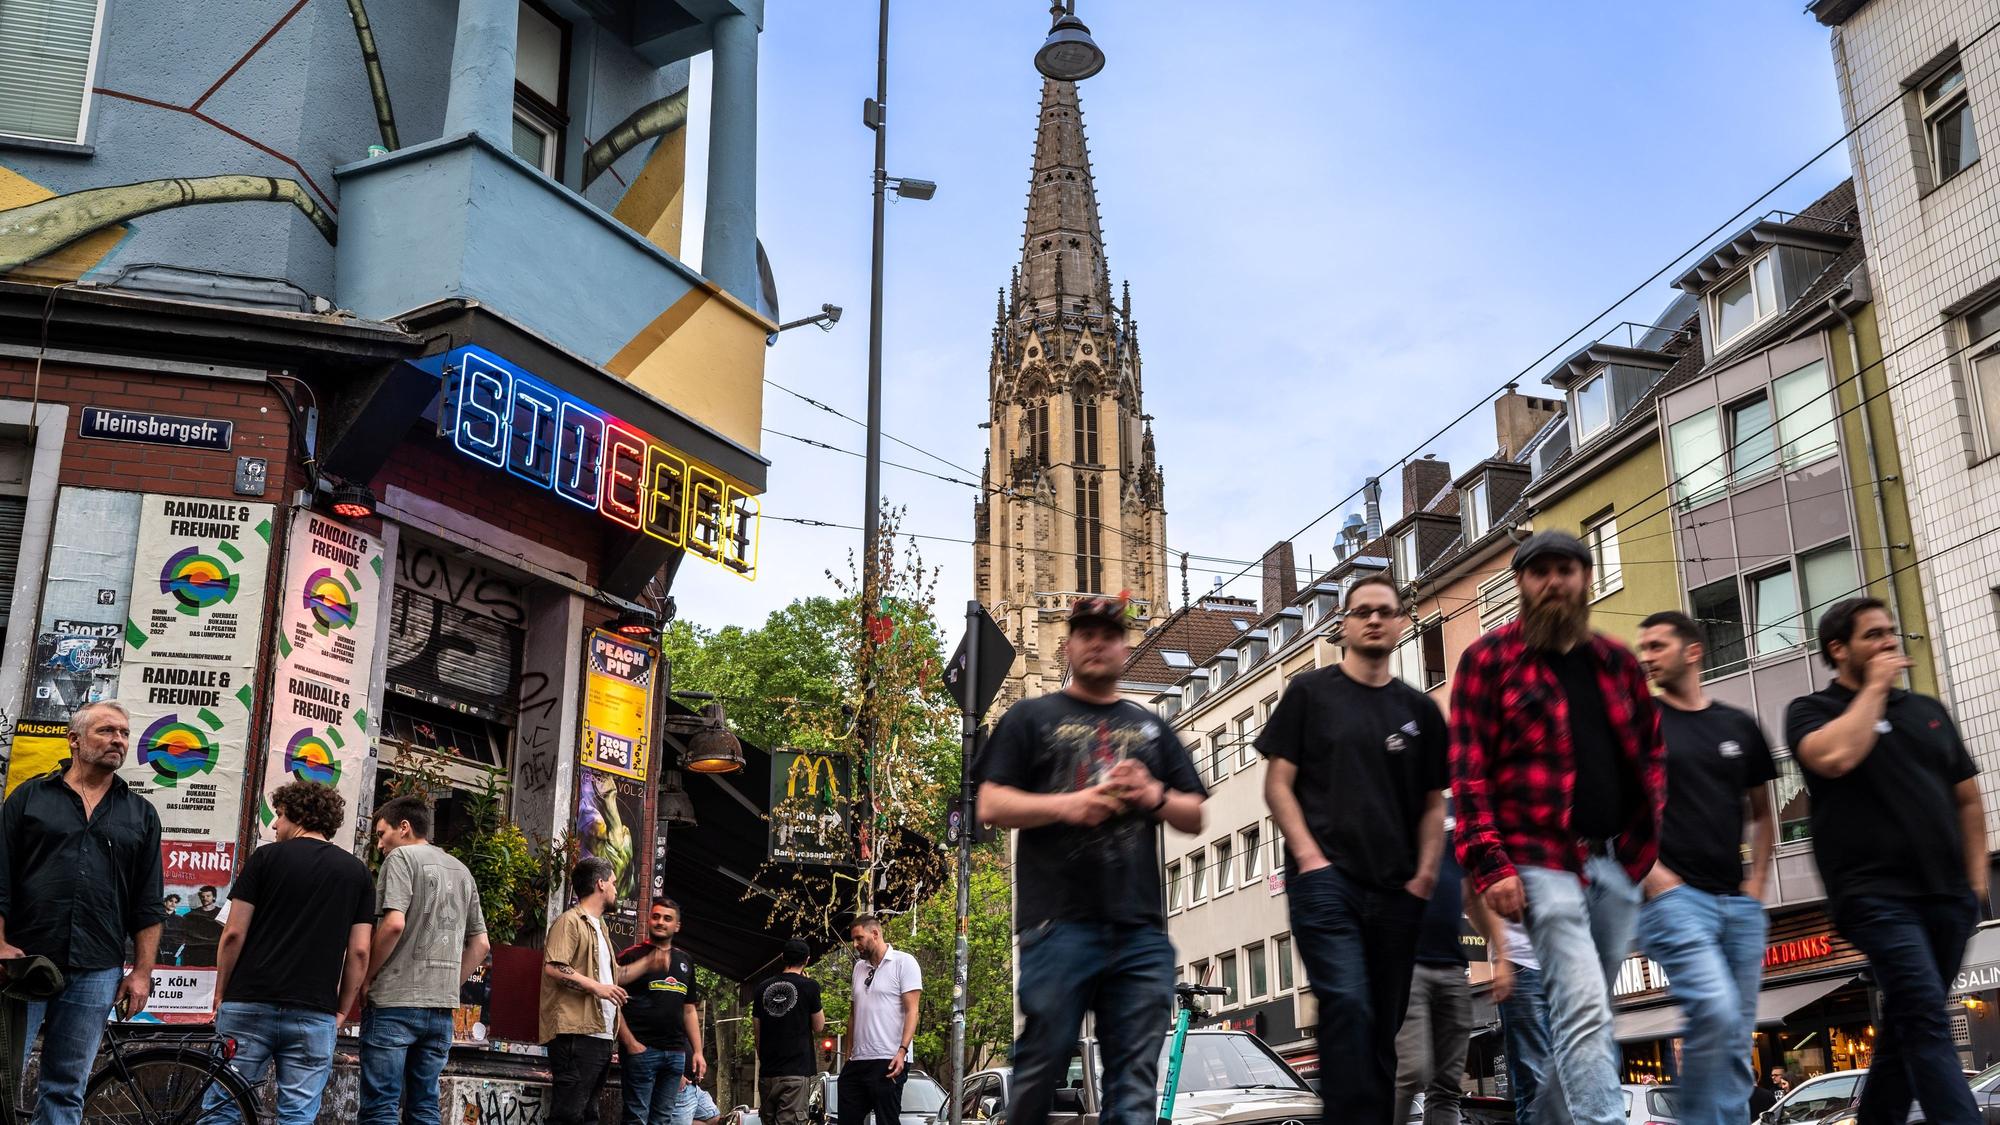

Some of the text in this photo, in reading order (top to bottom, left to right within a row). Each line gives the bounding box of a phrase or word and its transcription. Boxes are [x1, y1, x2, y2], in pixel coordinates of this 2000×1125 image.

[95, 411, 218, 442] Heinsbergstr.
[164, 501, 250, 522] RANDALE &
[170, 520, 240, 540] FREUNDE
[309, 518, 368, 554] RANDALE &
[312, 539, 360, 570] FREUNDE
[57, 620, 118, 638] 5vor12
[201, 631, 236, 639] LUMPENPACK
[151, 651, 232, 661] WWW.RANDALEUNDFREUNDE.DE
[596, 639, 645, 667] PEACH
[142, 667, 231, 688] RANDALE &
[606, 658, 631, 677] PIT
[148, 687, 220, 707] FREUNDE
[288, 677, 351, 709] RANDALE &
[292, 698, 343, 726] FREUNDE
[17, 723, 68, 734] MUSCHE
[600, 735, 628, 752] FROM
[161, 827, 210, 835] LEUNDFREUNDE.DE
[167, 850, 231, 872] SPRING
[1782, 935, 1831, 964] DRINKS
[168, 975, 197, 987] KÖLN
[158, 991, 184, 999] CLUB
